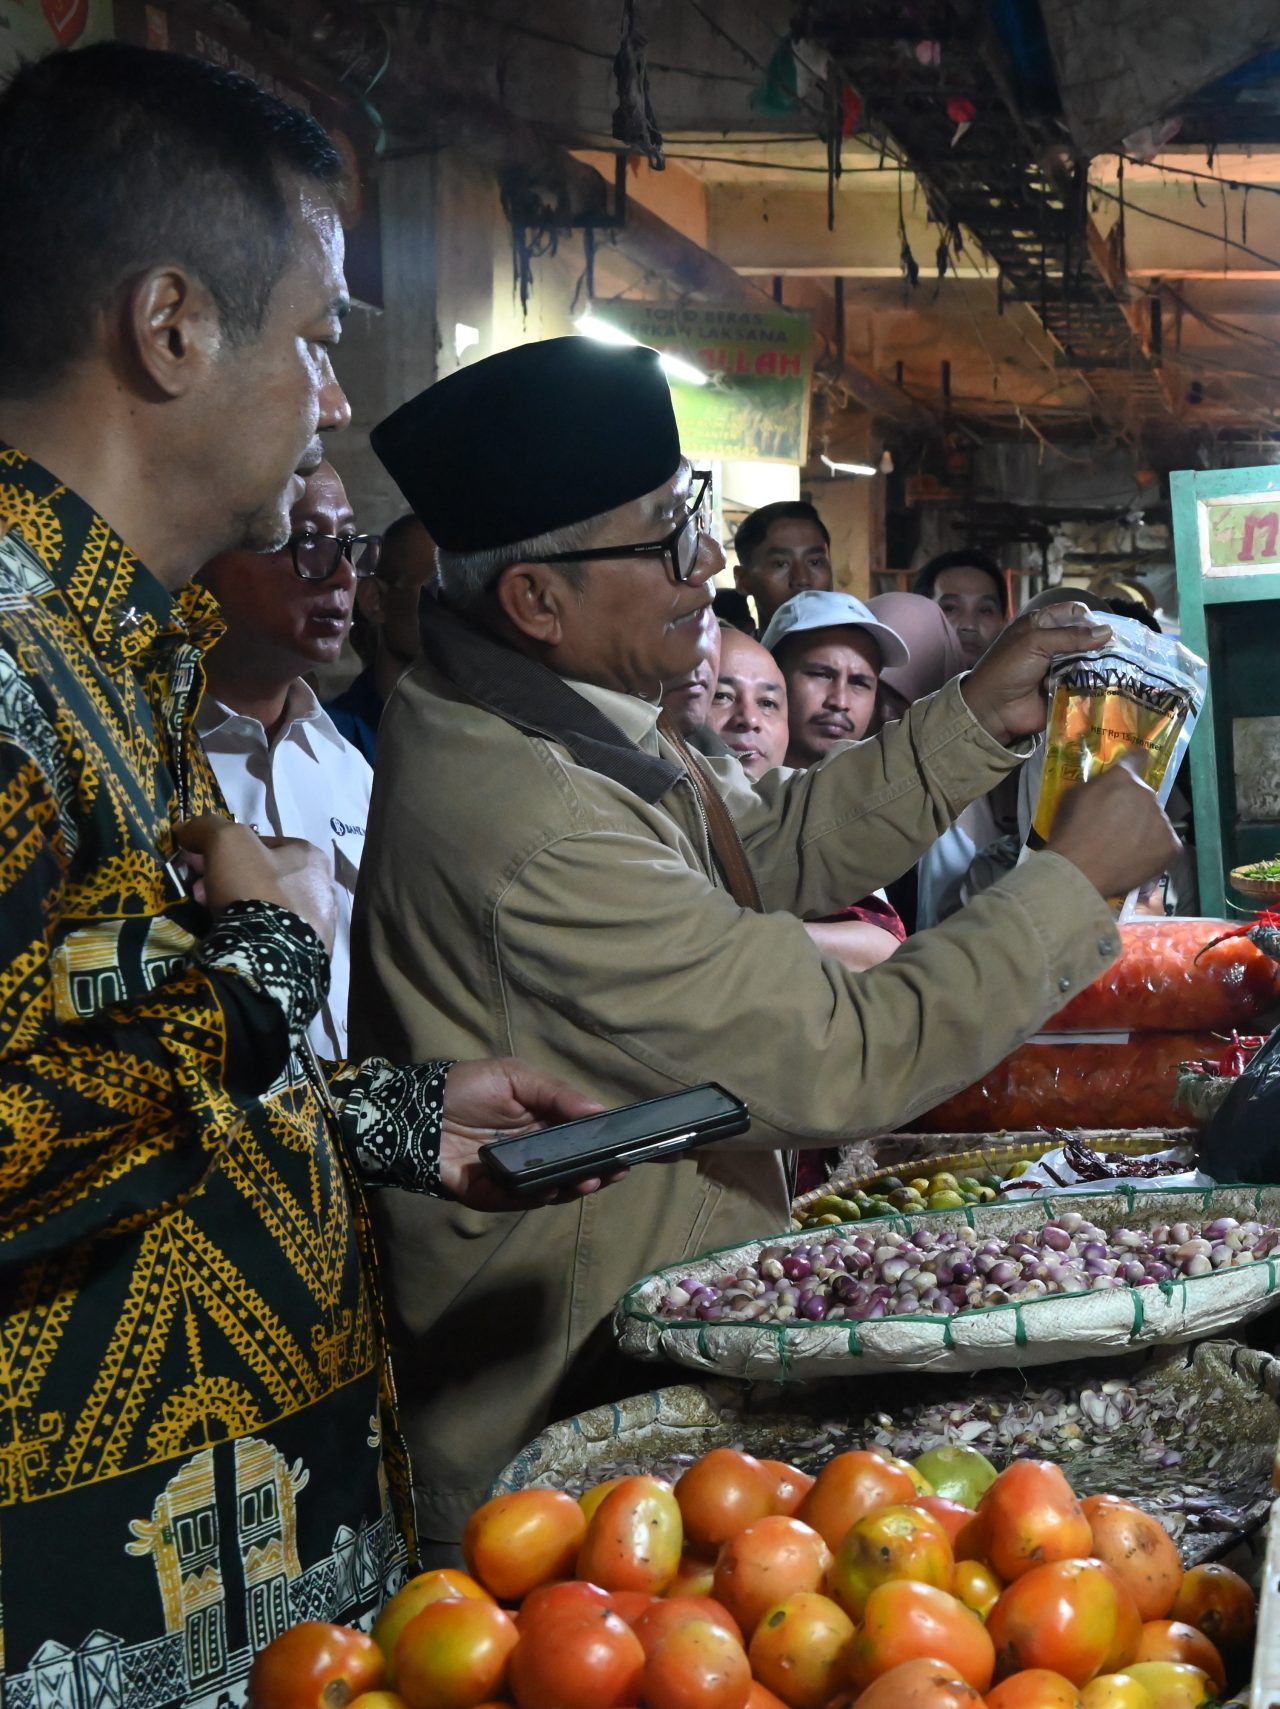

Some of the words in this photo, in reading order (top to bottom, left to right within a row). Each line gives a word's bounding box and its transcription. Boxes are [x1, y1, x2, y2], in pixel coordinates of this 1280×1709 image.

[704, 311, 764, 325] BERAS
[698, 327, 788, 344] LAKSANA
[1108, 729, 1120, 739] Rp
